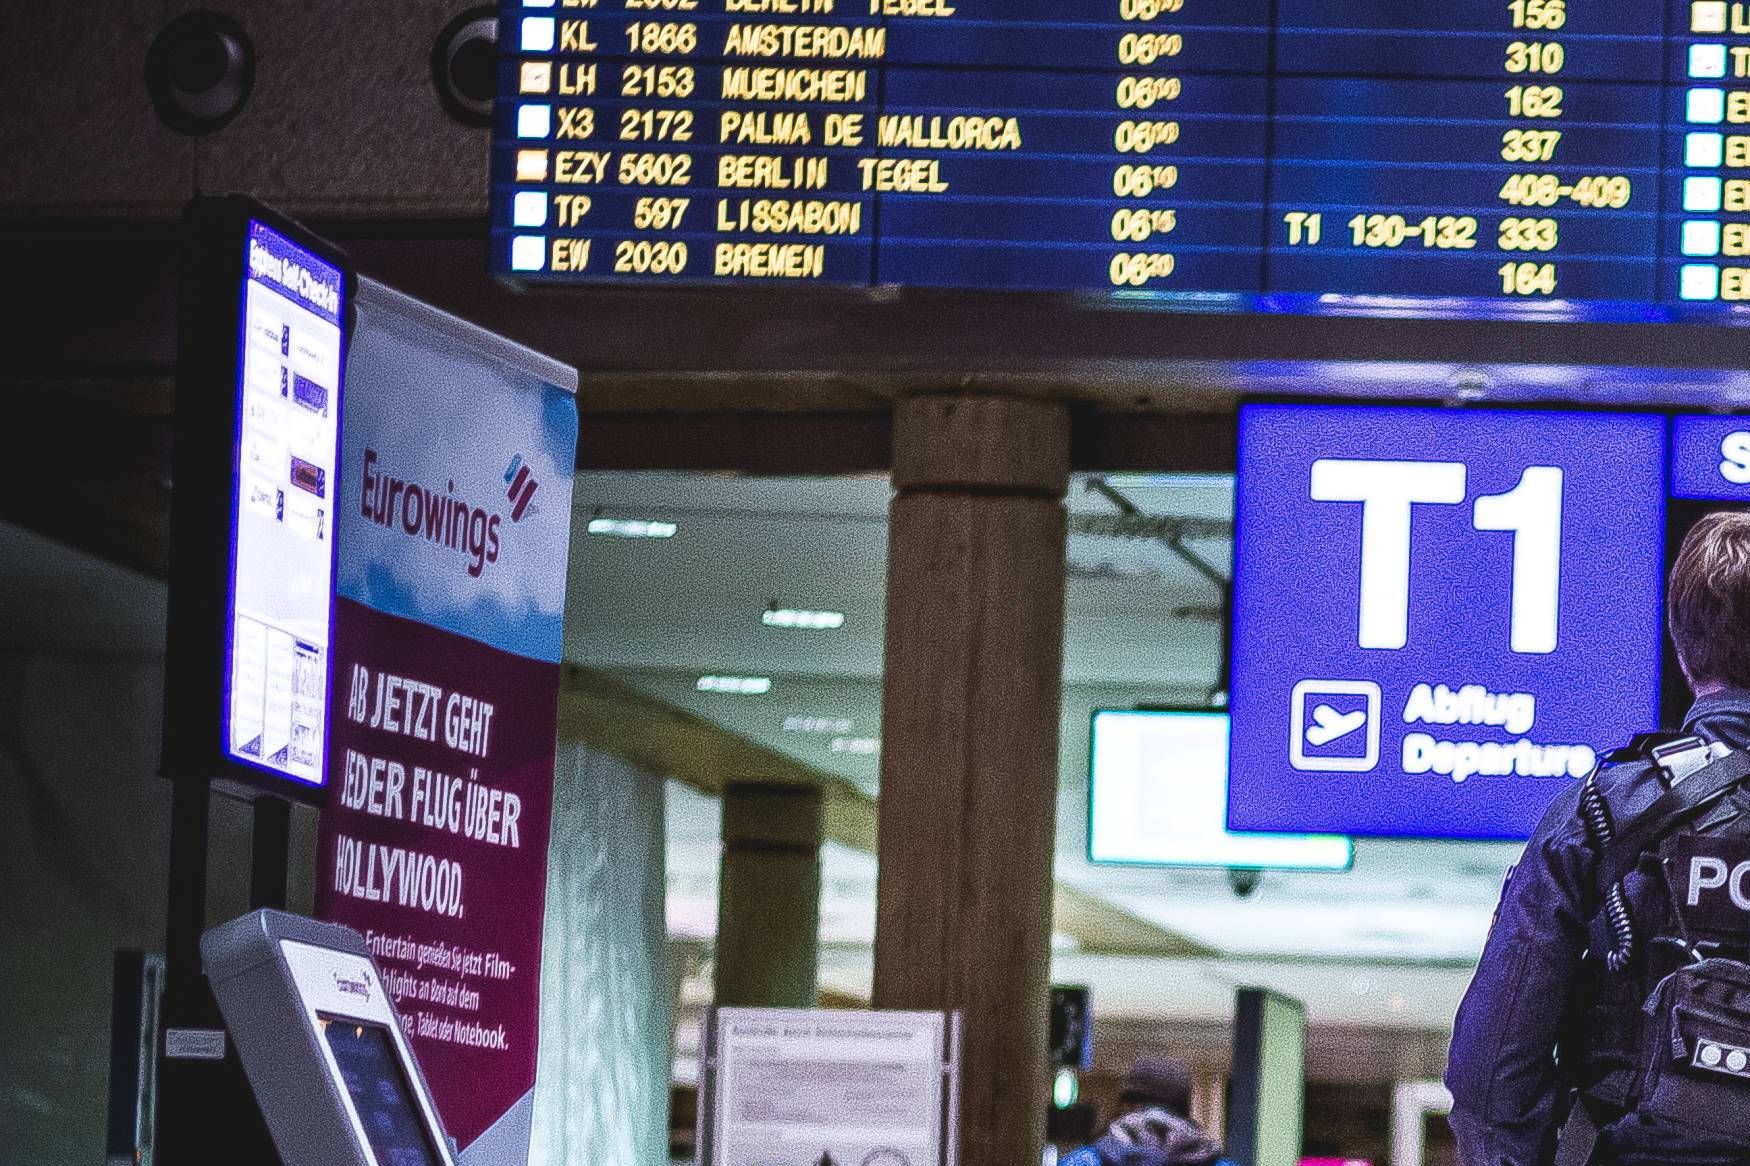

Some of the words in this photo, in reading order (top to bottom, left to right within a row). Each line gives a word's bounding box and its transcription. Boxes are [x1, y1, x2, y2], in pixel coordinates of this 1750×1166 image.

[560, 20, 597, 52] KL
[625, 21, 697, 54] 1866
[723, 23, 886, 57] AMSTERDAM
[1505, 41, 1564, 74] 310
[558, 63, 597, 96] LH
[621, 64, 695, 98] 2153
[721, 66, 866, 102] MUENCHEN
[1505, 85, 1563, 118] 162
[556, 107, 594, 139] X3
[619, 108, 694, 142] 2172
[720, 110, 812, 145] PALMA
[824, 113, 864, 147] DE
[877, 115, 1022, 150] MALLORCA
[1501, 129, 1561, 162] 337
[554, 150, 611, 184] EZY
[618, 153, 692, 186] 5602
[718, 154, 828, 190] BERLIN
[857, 158, 949, 193] TEGEL
[1499, 173, 1631, 209] 408-409
[554, 194, 592, 227] TP
[634, 197, 690, 230] 597
[717, 198, 861, 235] LISSABON
[1285, 212, 1320, 245] T1
[1350, 214, 1477, 249] 130-132
[1498, 217, 1558, 251] 333
[551, 238, 591, 271] EW
[614, 240, 688, 274] 2030
[714, 242, 825, 278] BREMEN
[360, 447, 502, 579] Eurowings
[1309, 457, 1565, 655] T1
[347, 663, 369, 724] AB
[370, 672, 443, 742] JETZT
[444, 692, 494, 758] GEHT
[1402, 682, 1536, 735] Abflug
[1402, 731, 1597, 783] Departure
[340, 748, 406, 820] JEDER
[410, 766, 463, 835] FLUG
[464, 768, 521, 848] ÜBER
[334, 833, 464, 919] HOLLYWOOD.
[366, 929, 416, 961] Entertain
[461, 949, 483, 979] jetzt
[484, 952, 516, 980] Film-
[381, 967, 417, 1003] hlights
[418, 979, 430, 999] an
[458, 989, 480, 1011] dem
[454, 1020, 510, 1051] Notebook.
